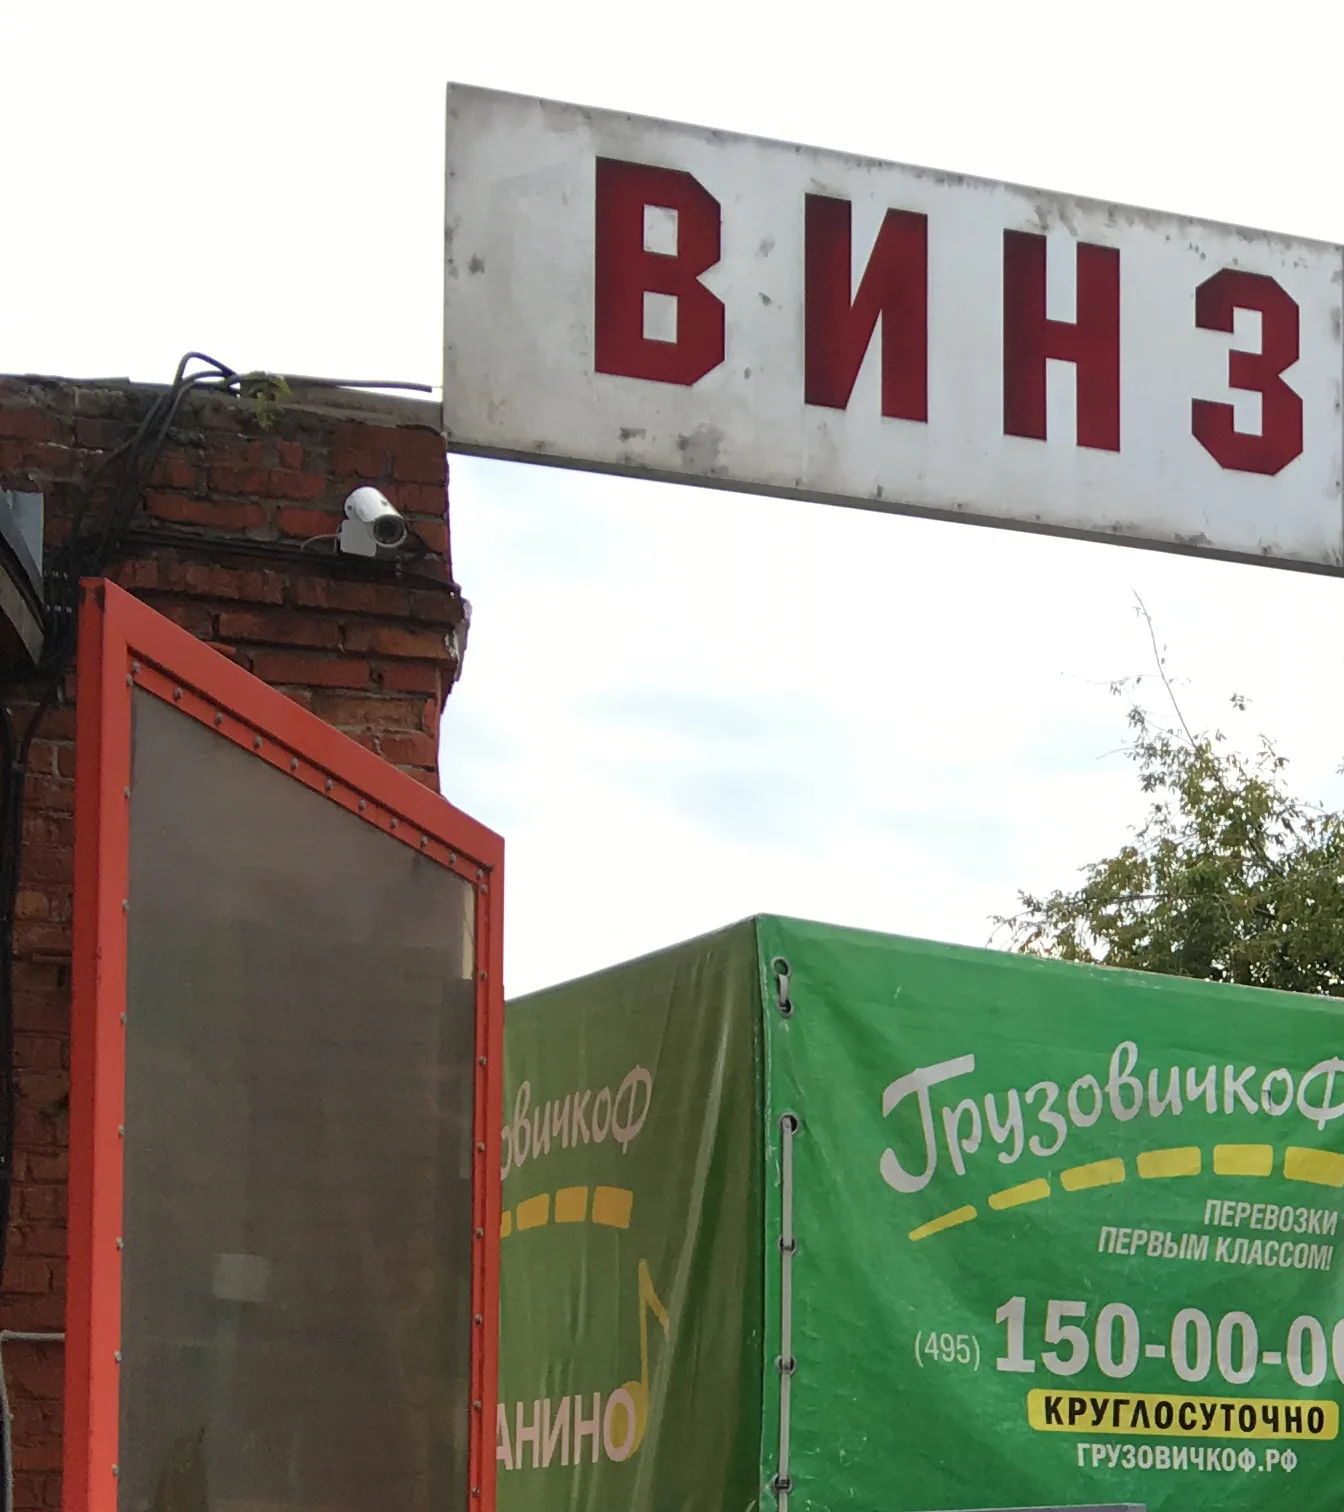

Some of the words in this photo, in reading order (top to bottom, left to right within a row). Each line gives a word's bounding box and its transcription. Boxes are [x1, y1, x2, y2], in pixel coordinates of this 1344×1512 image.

[1204, 1199, 1339, 1237] ПЕРЕВОЗКИ
[1098, 1225, 1208, 1262] ПЕРВЫМ
[1214, 1236, 1335, 1272] КЛАССОМ!
[913, 1330, 982, 1372] (495)
[1044, 1396, 1326, 1435] КРУГЛОСУТОЧНО
[1076, 1443, 1299, 1474] ГРУЗОВИЧКОФ.РФ
